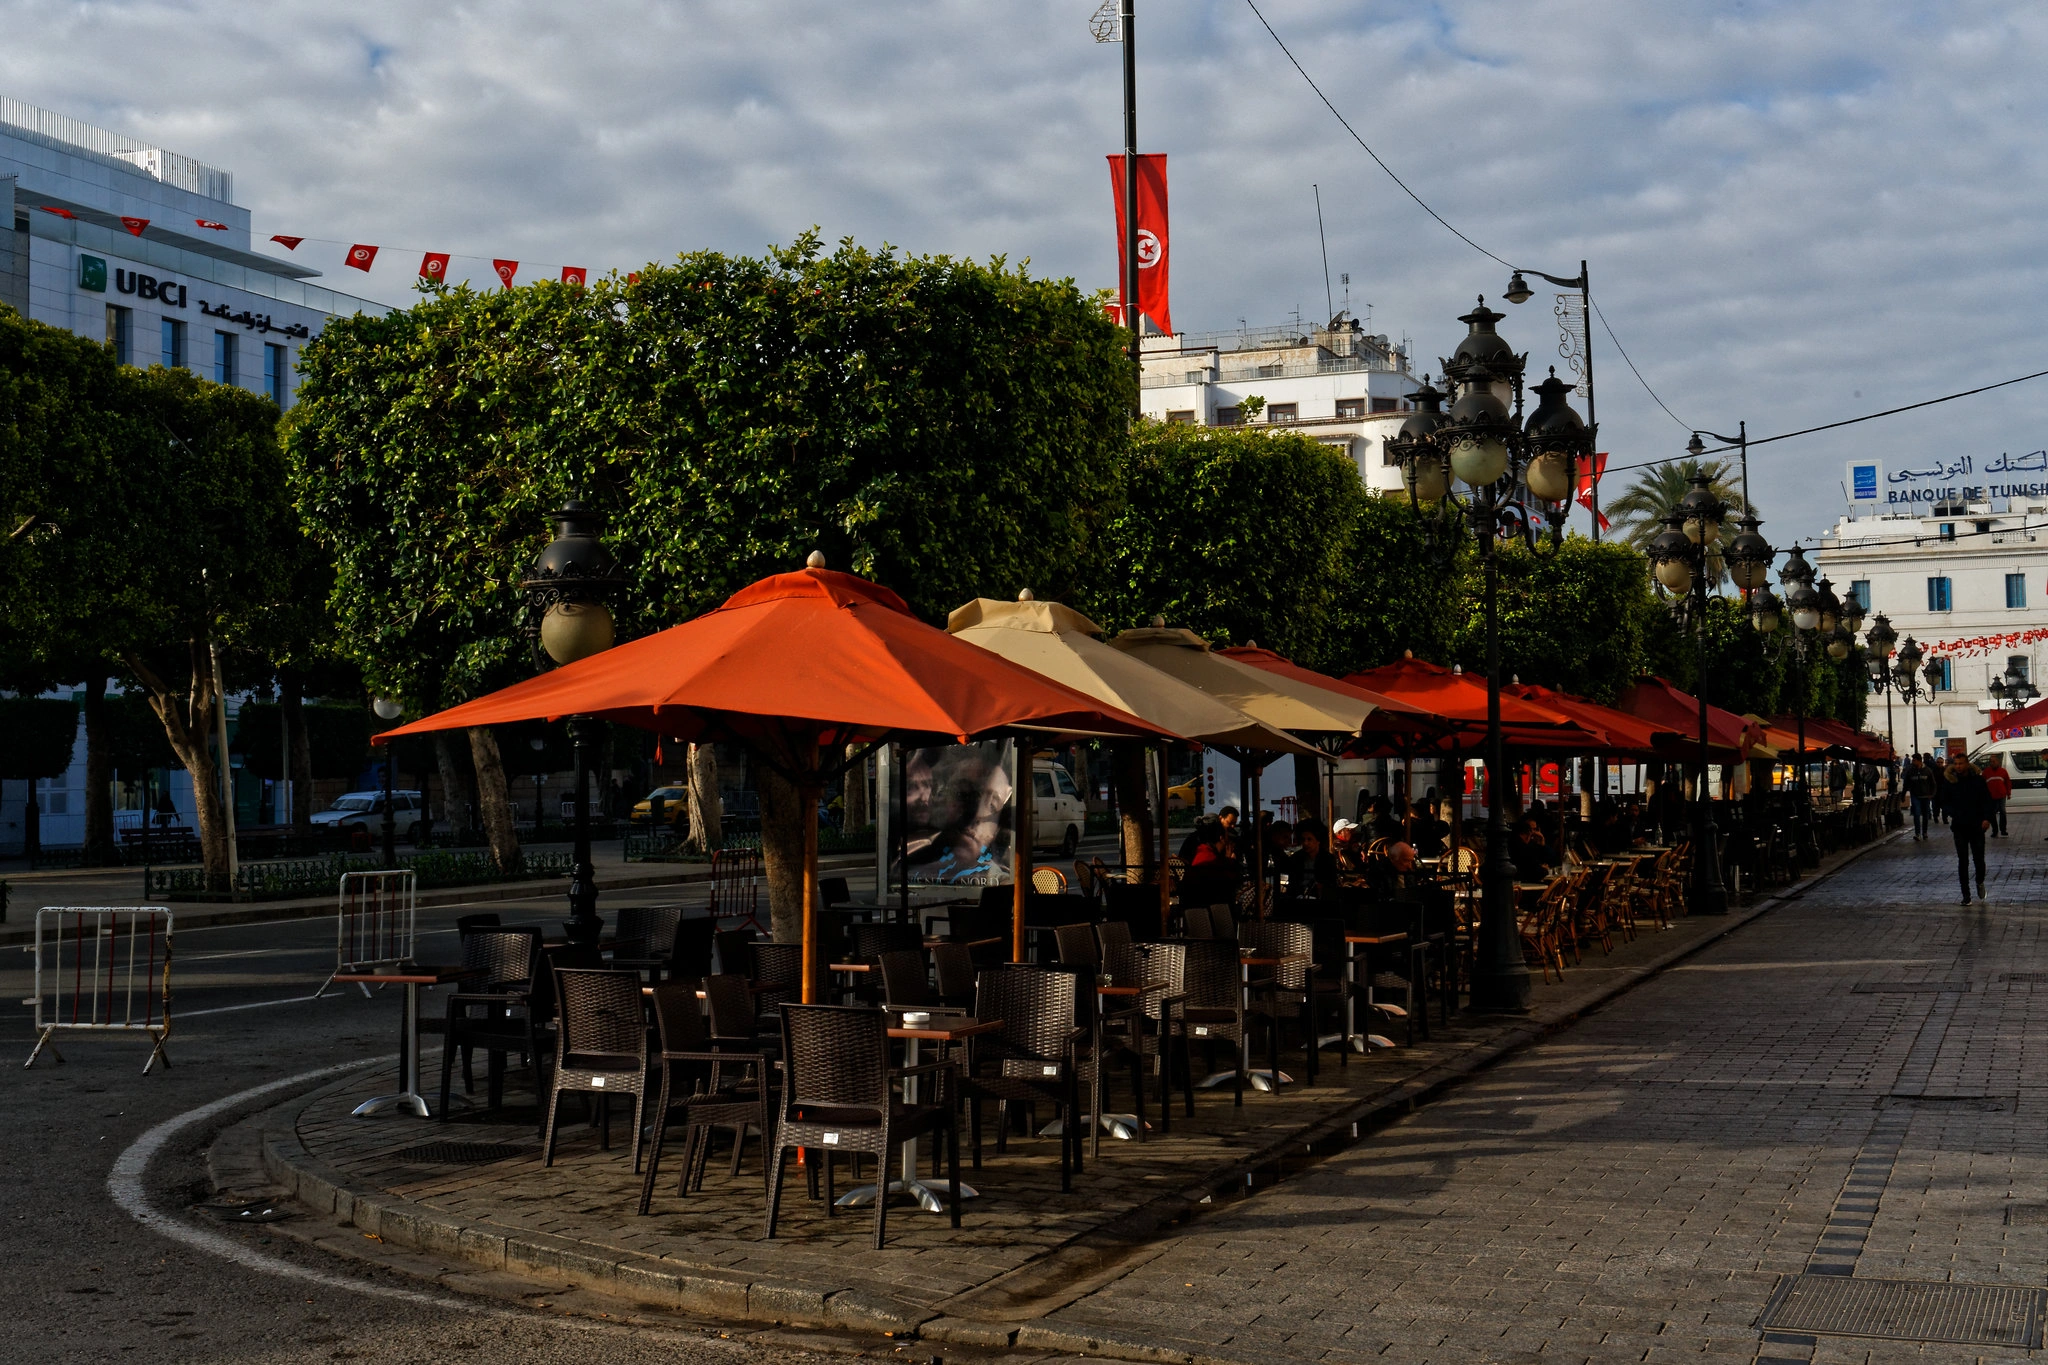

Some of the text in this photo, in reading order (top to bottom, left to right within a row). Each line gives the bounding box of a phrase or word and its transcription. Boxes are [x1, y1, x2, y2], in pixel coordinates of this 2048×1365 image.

[116, 268, 187, 309] UBCI
[1888, 450, 2048, 483] لبنك التونسي
[1888, 487, 1956, 503] BANQUE
[1962, 486, 1982, 500] DE
